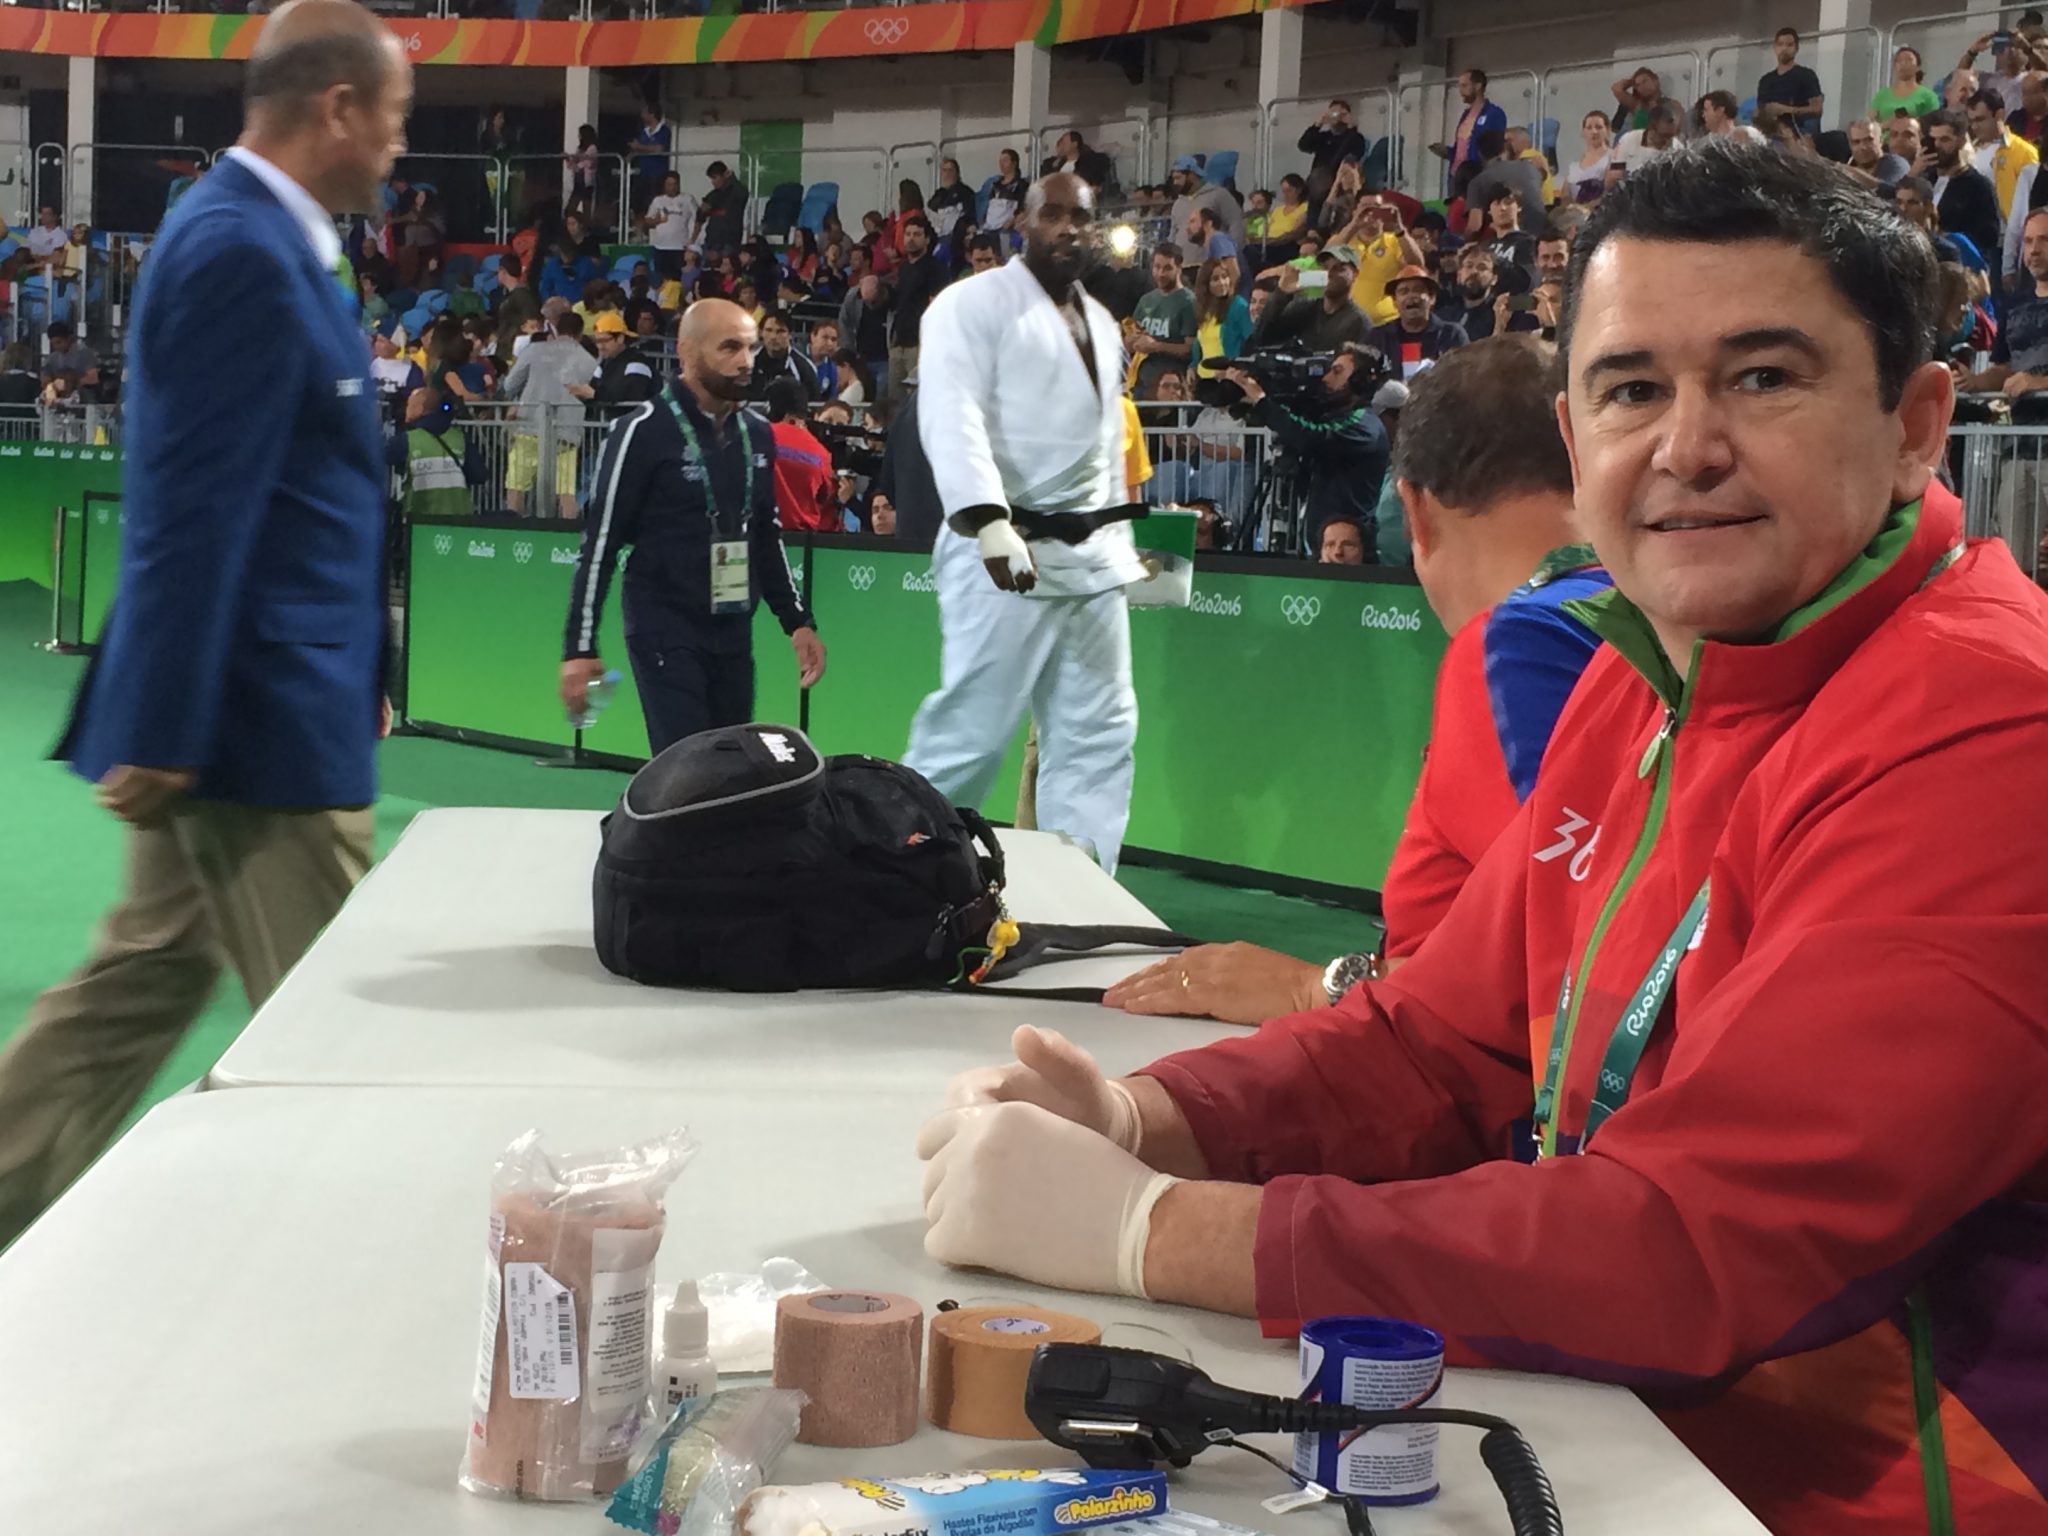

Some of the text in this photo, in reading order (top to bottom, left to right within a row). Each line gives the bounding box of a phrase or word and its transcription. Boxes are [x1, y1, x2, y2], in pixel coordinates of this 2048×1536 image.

[1190, 591, 1242, 617] Rio2016
[1361, 604, 1422, 632] Rio2016
[1626, 947, 1678, 1037] Rio2016
[1069, 1488, 1154, 1521] Polarzinho
[943, 1516, 975, 1530] Hastes
[1018, 1507, 1038, 1517] com
[984, 1524, 995, 1534] de
[997, 1517, 1035, 1533] Algodão
